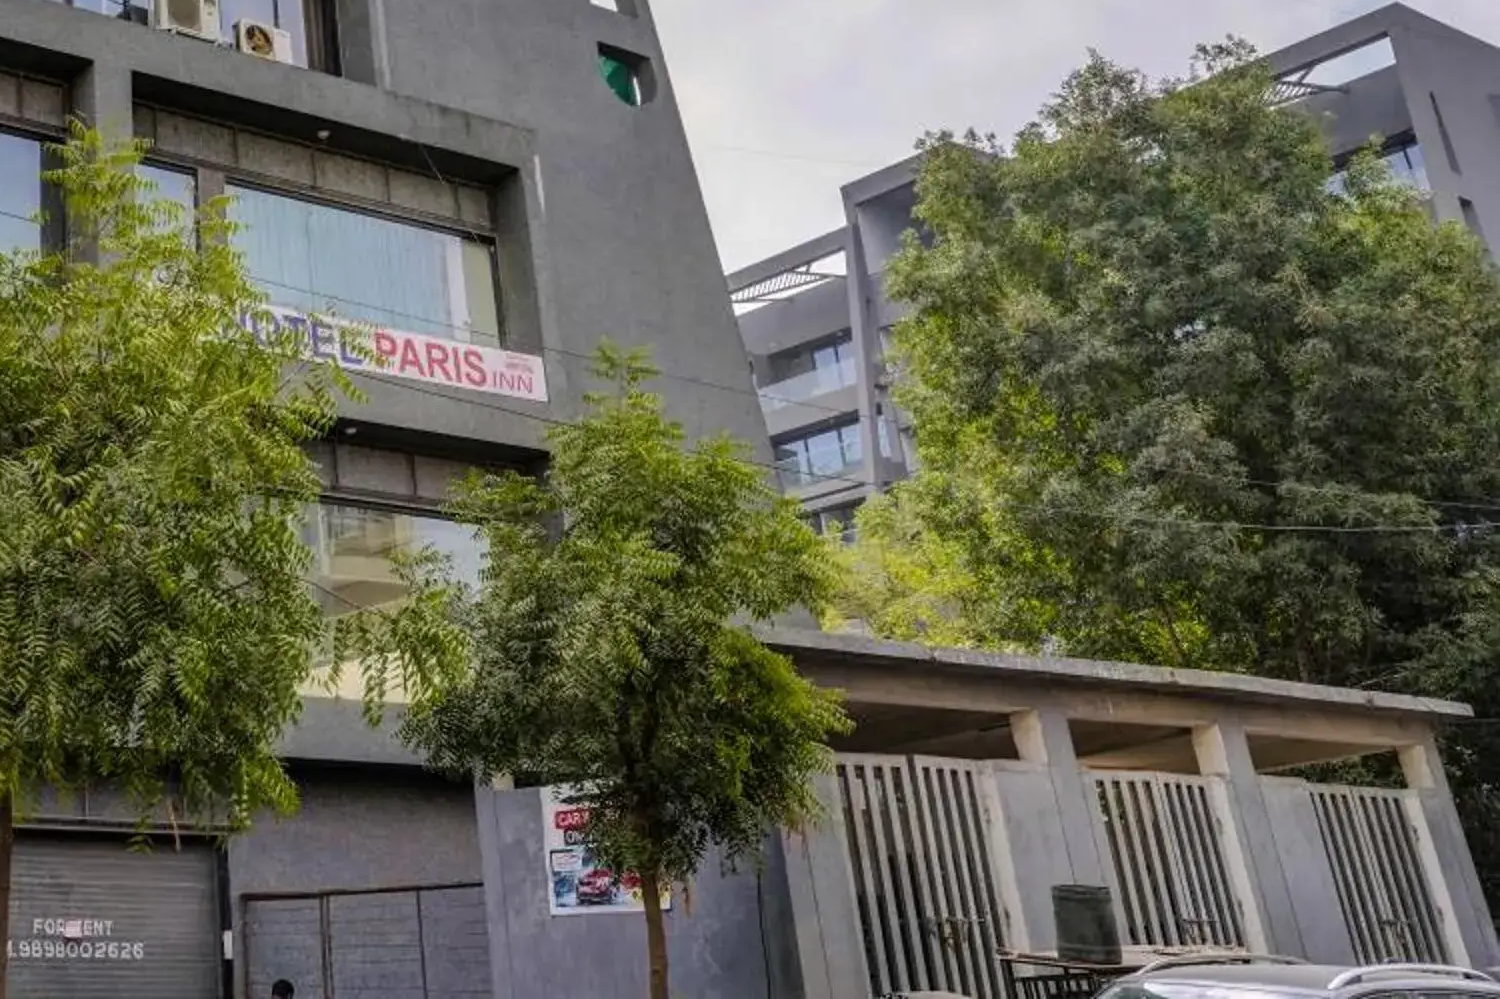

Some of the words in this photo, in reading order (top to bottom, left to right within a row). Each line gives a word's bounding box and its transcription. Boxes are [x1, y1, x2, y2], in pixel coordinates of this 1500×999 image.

[222, 309, 364, 365] OTEL
[374, 332, 487, 387] PARIS
[492, 372, 533, 393] INN
